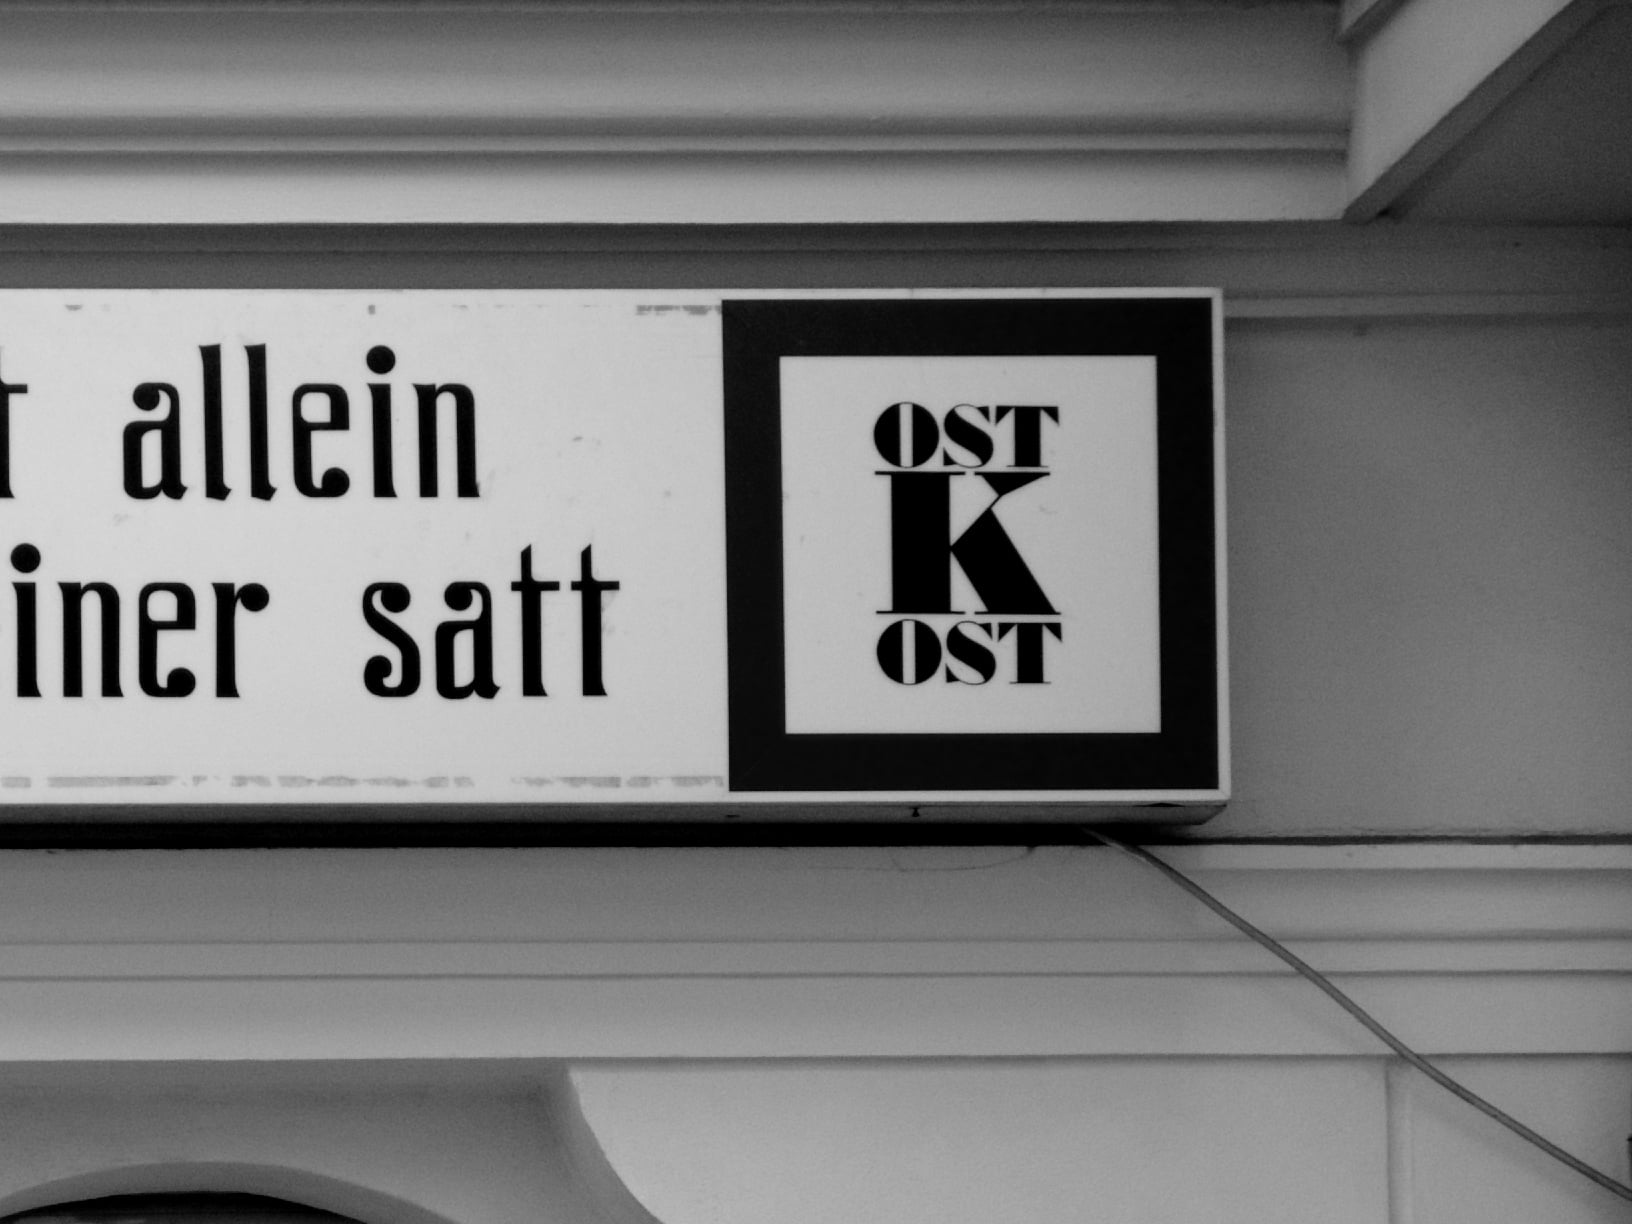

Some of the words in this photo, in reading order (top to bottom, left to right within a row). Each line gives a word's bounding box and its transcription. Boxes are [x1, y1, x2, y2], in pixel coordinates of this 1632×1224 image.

[123, 345, 480, 501] allein
[873, 402, 1060, 468] OST
[875, 471, 1062, 615] K
[362, 544, 620, 700] satt
[876, 618, 1063, 686] OST
